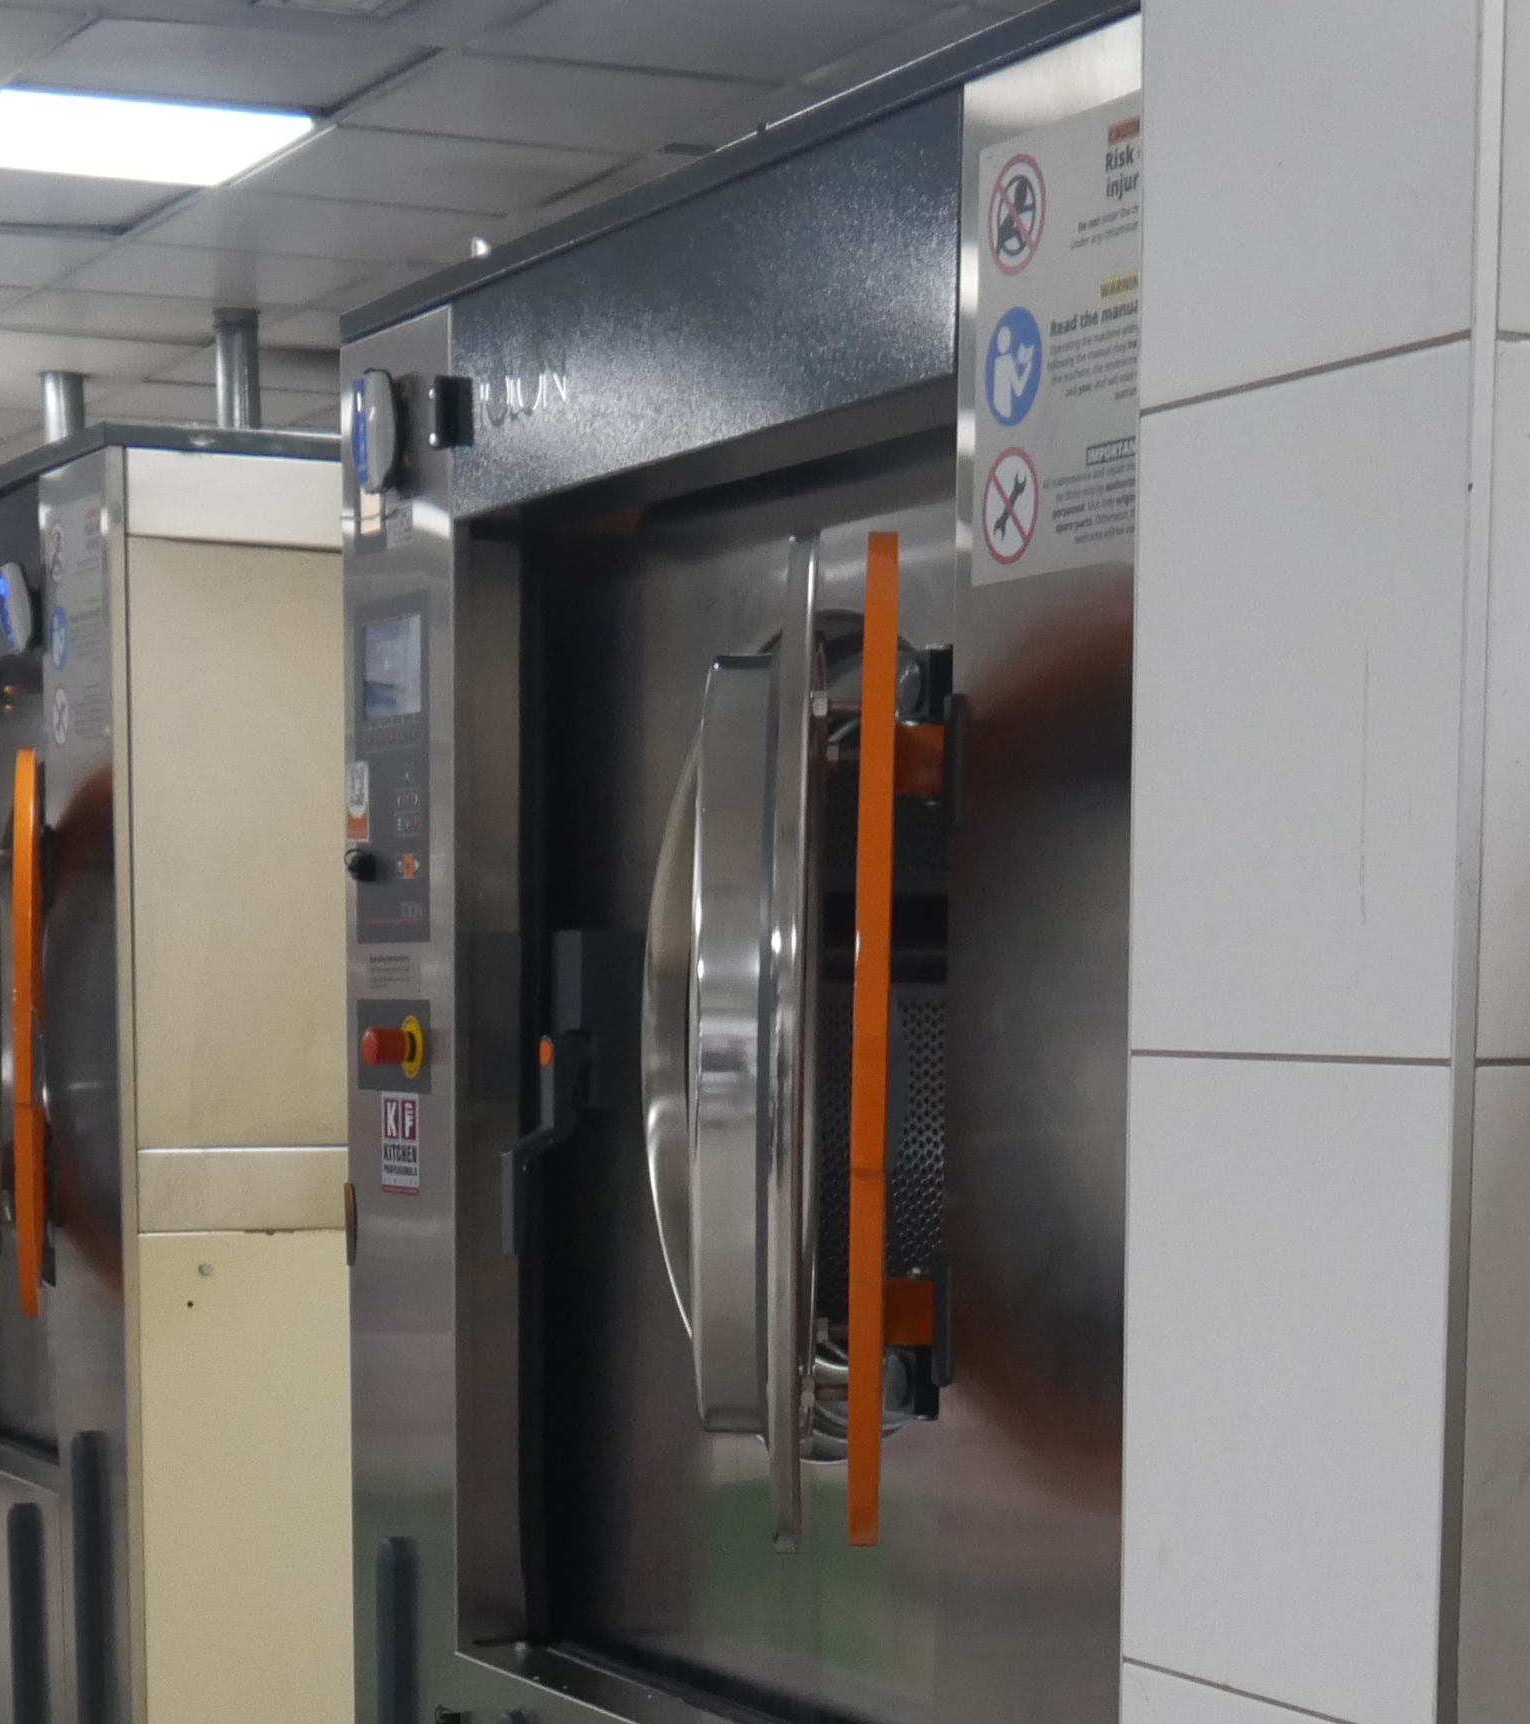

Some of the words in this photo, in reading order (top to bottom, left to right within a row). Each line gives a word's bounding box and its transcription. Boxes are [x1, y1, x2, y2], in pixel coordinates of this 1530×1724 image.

[1105, 144, 1134, 172] Risk
[1050, 314, 1077, 337] Read
[1080, 309, 1098, 329] the
